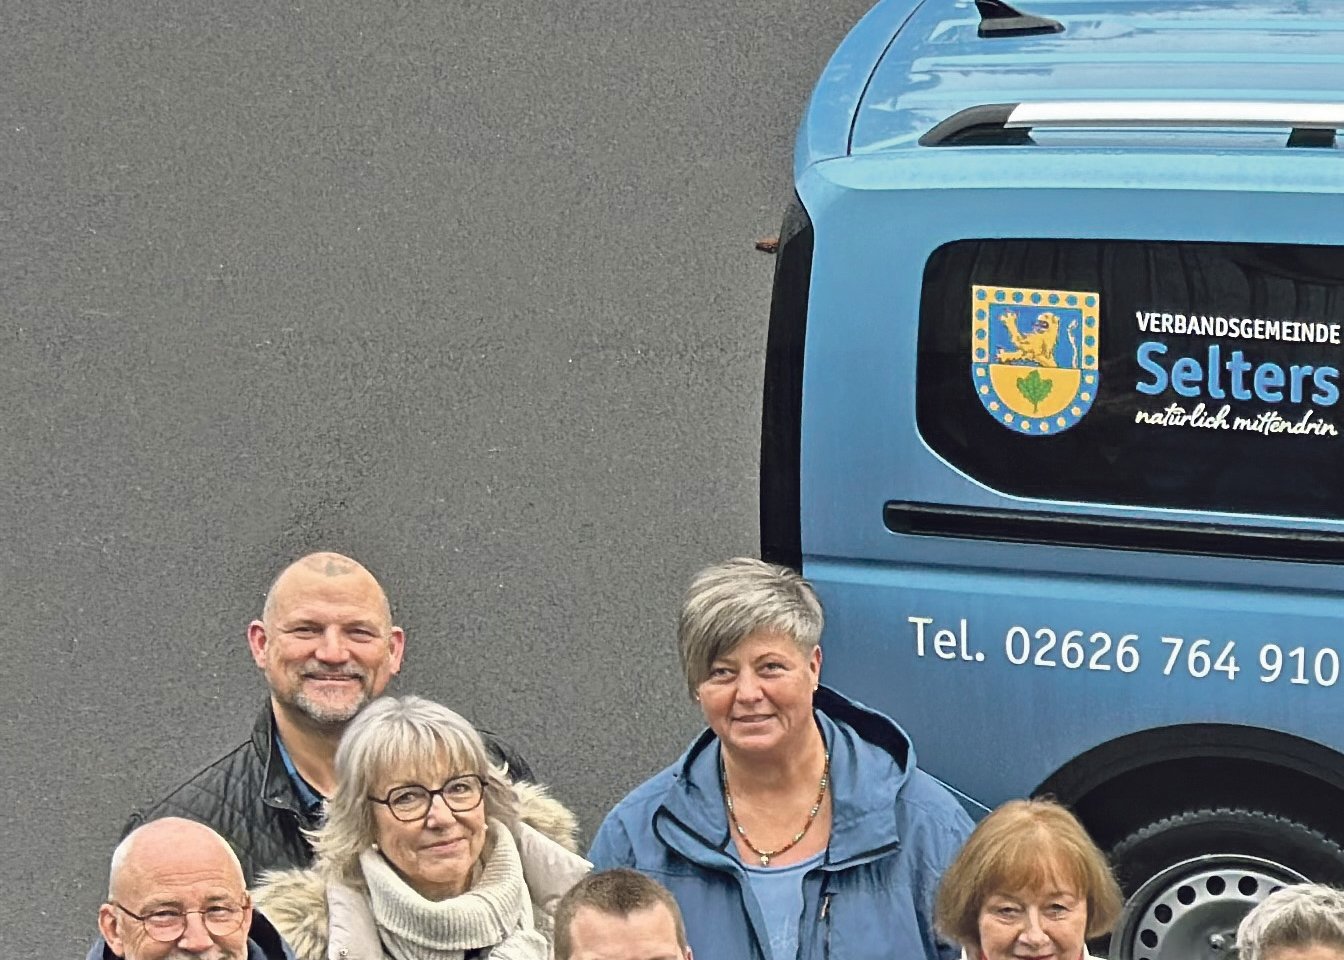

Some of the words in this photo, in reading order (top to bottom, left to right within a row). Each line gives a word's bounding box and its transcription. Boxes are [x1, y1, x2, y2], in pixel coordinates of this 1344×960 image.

[1135, 311, 1342, 345] VERBANDSGEMEINDE
[1135, 342, 1340, 406] Selters
[1134, 402, 1231, 430] natürlich
[1231, 409, 1339, 436] mittendrin
[908, 616, 985, 662] Tel.
[1005, 626, 1140, 674] 02626
[1161, 636, 1241, 681] 764
[1259, 643, 1340, 687] 910
